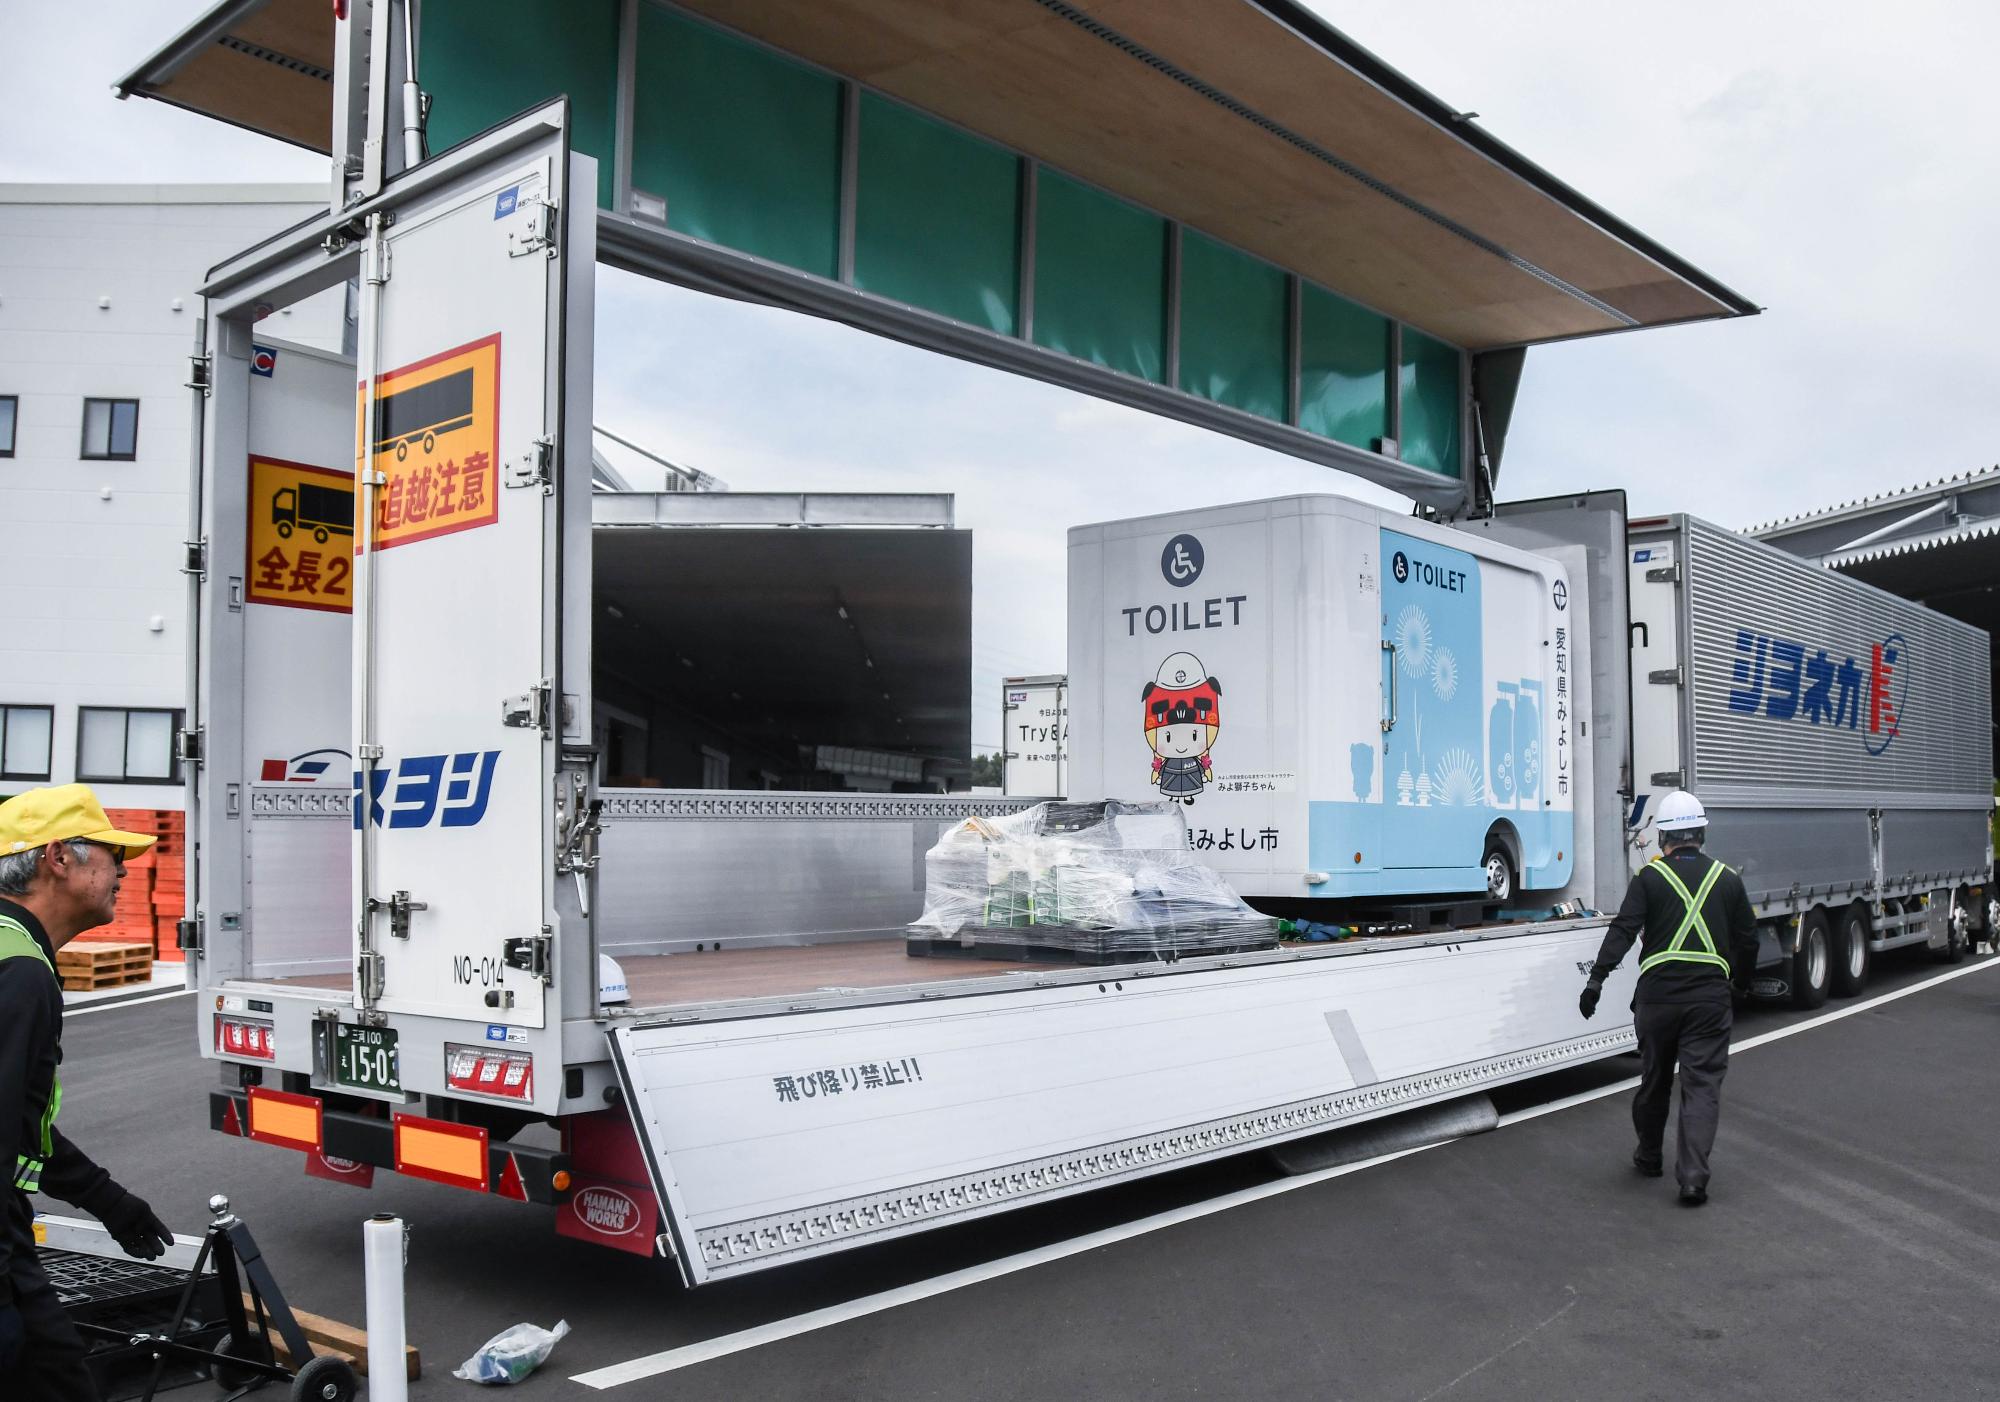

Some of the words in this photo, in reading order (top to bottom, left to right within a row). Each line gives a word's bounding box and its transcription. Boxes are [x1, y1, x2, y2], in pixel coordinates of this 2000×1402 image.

[380, 451, 489, 531] 追越注意
[255, 546, 350, 595] 全長2
[1413, 560, 1466, 593] TOILET
[1122, 596, 1247, 636] TOILET
[1554, 627, 1569, 797] 愛知県みよし市
[454, 955, 504, 988] NO-014
[773, 1058, 923, 1102] 飛び降り禁止!!
[583, 1192, 630, 1216] HAMANA
[587, 1207, 625, 1229] WORKS
